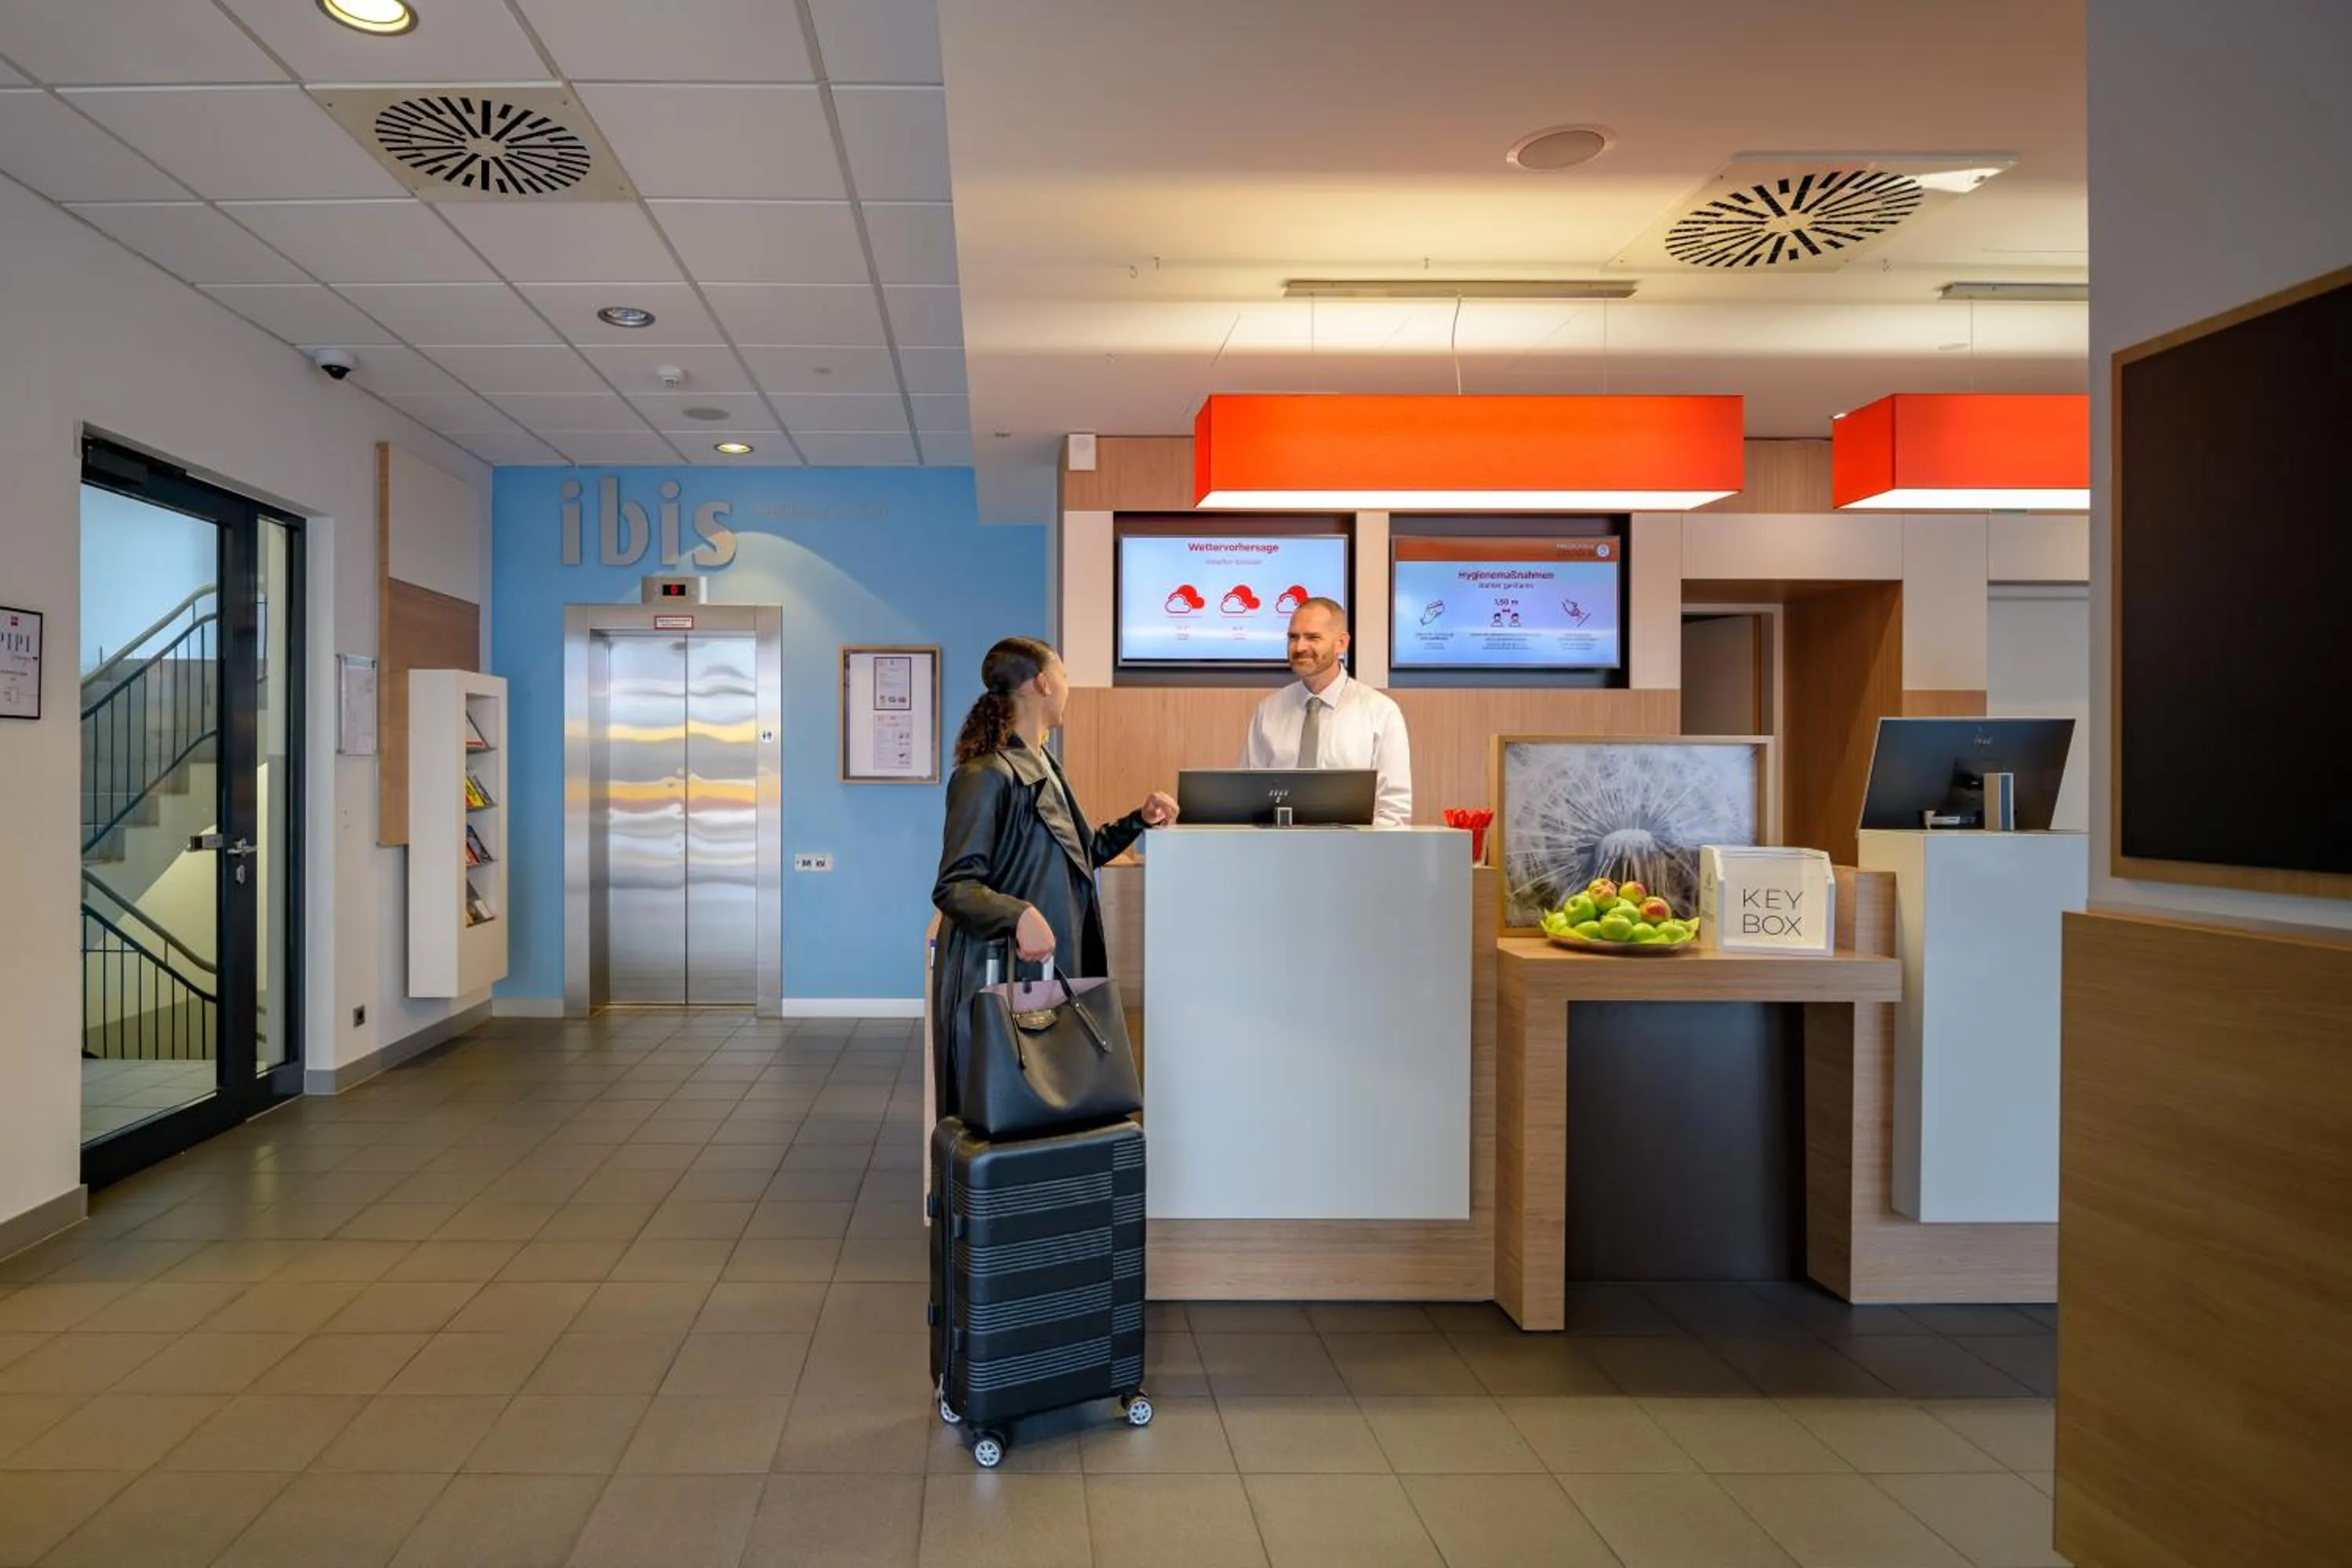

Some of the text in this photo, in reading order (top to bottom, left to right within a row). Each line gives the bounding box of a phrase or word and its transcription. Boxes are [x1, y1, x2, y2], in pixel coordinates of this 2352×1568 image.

[561, 476, 737, 568] ibis
[1188, 543, 1279, 554] Wettervorhersage
[1743, 888, 1803, 910] KEY
[1743, 913, 1802, 937] BOX
